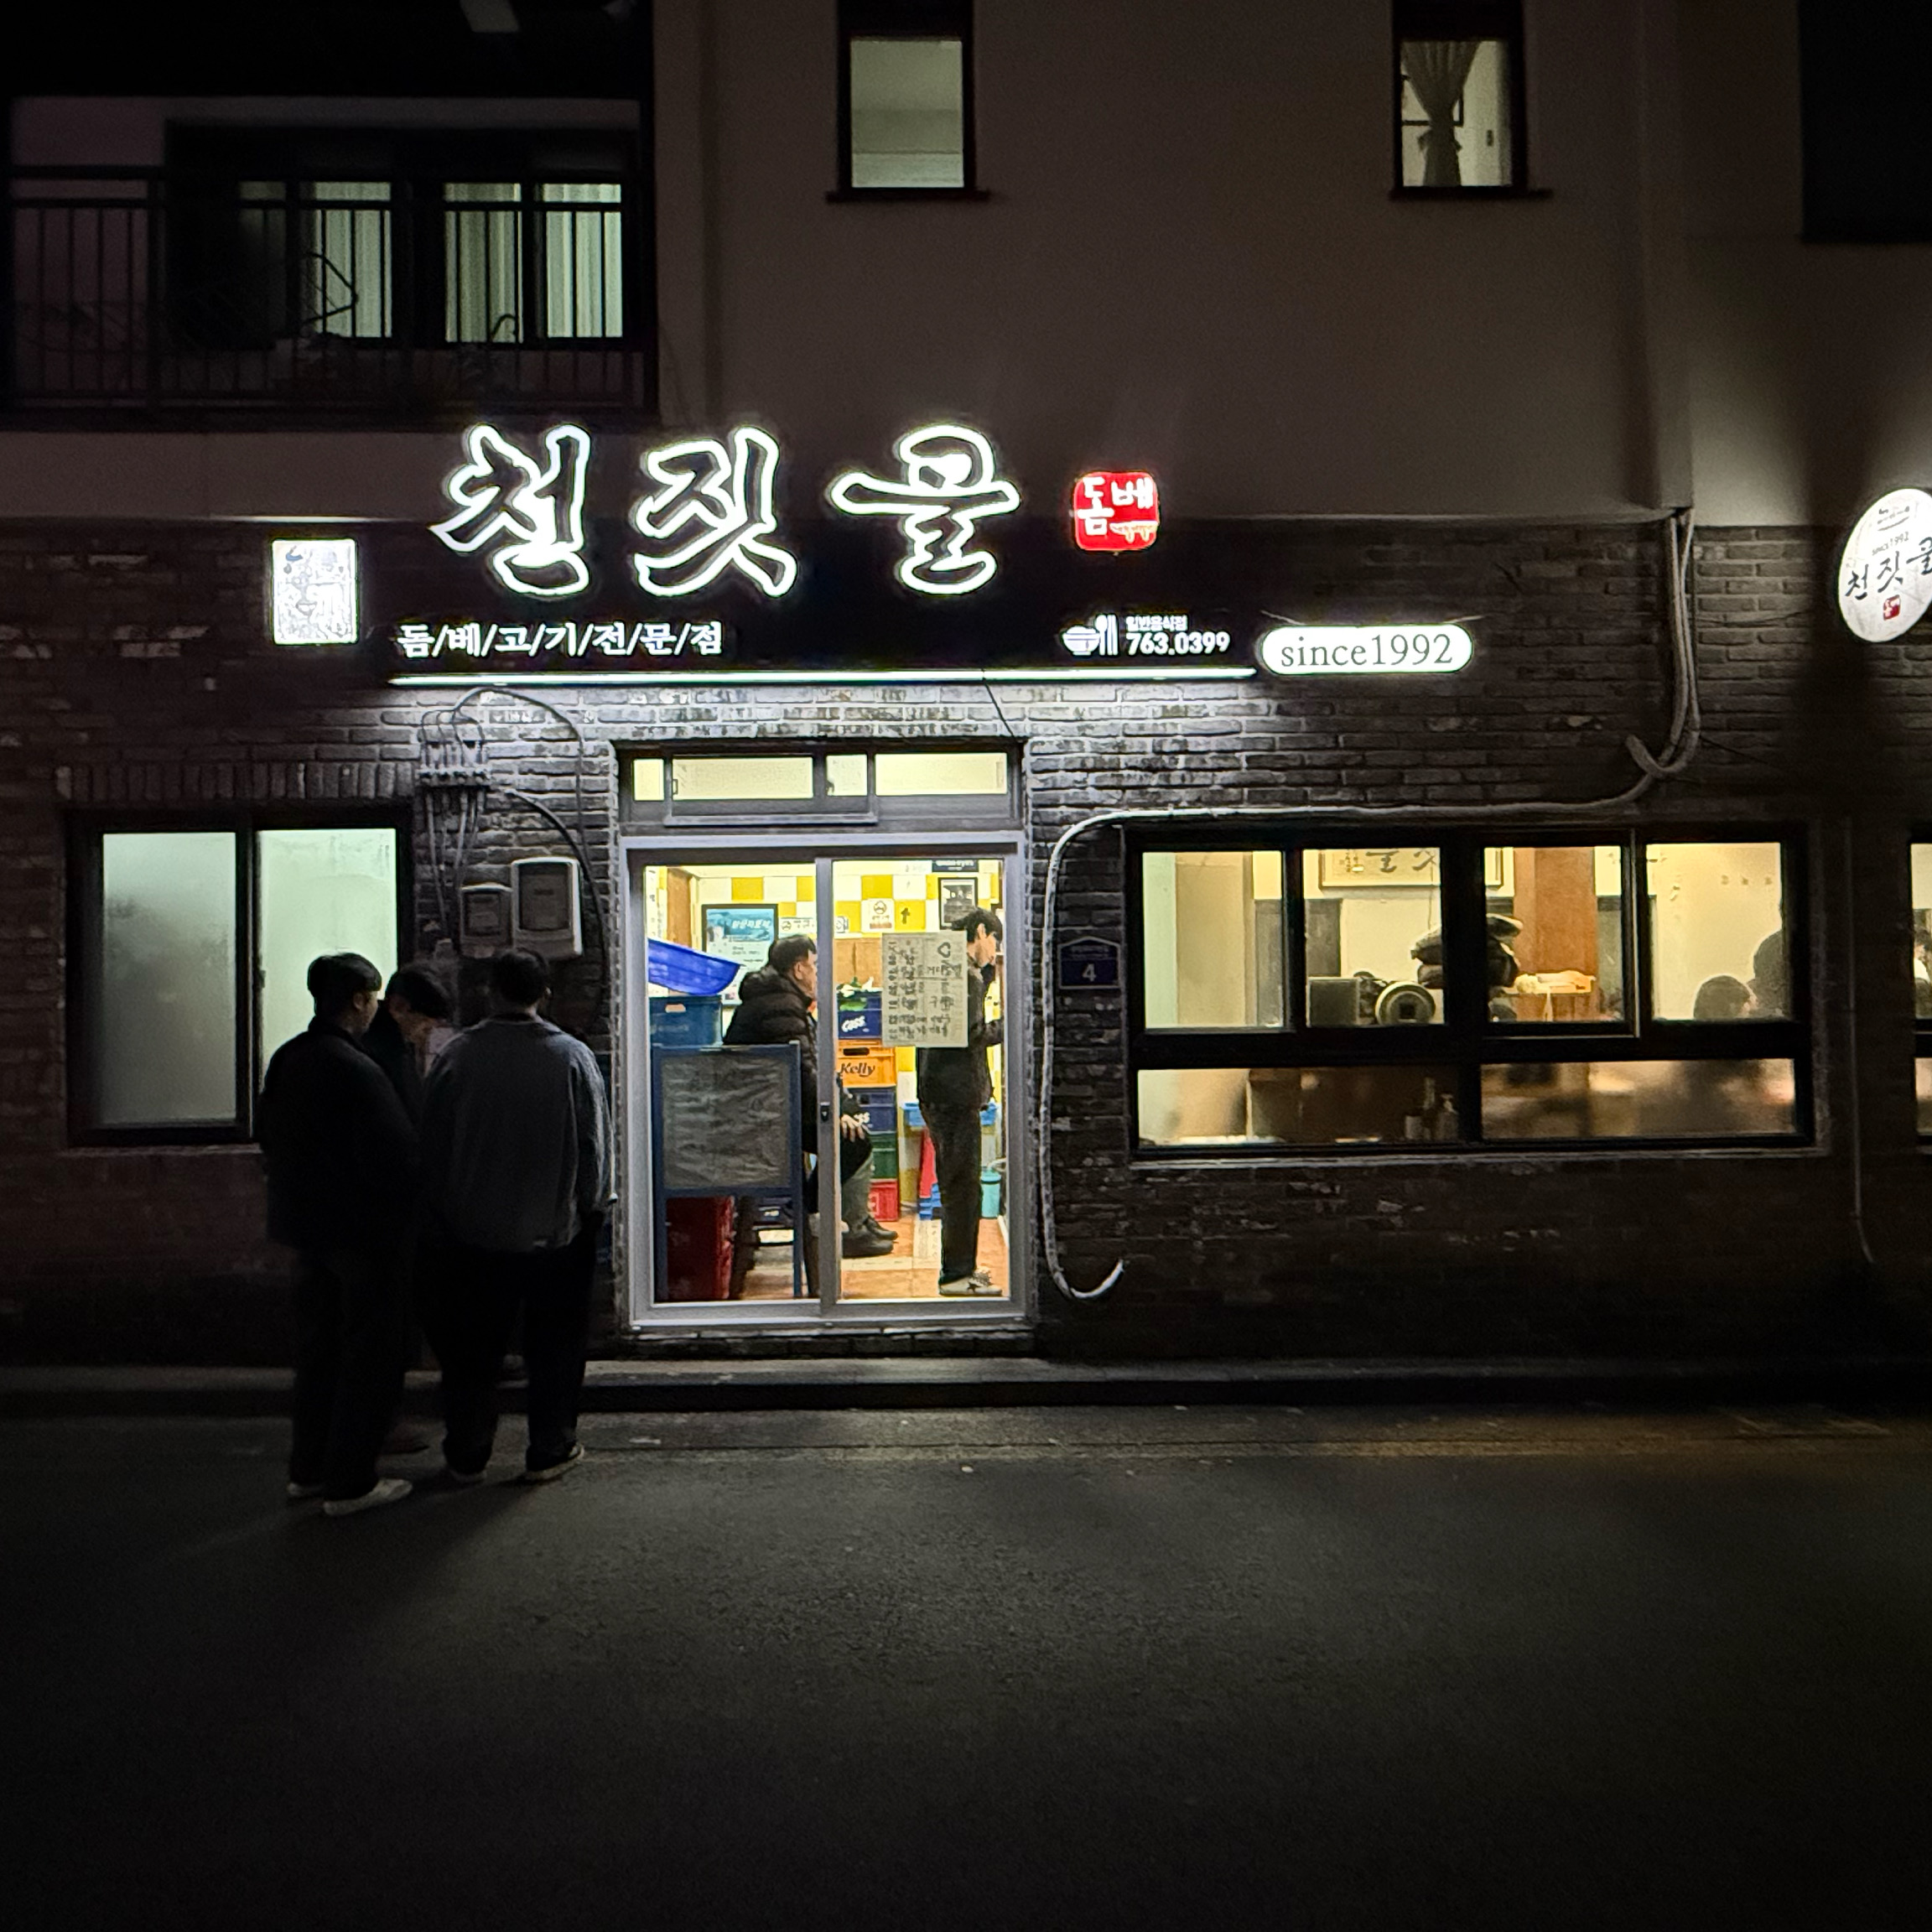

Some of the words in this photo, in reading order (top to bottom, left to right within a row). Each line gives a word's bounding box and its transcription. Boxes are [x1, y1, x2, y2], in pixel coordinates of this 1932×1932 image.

[1125, 631, 1231, 656] 763.0399
[1082, 963, 1097, 982] 4
[840, 1062, 875, 1078] Kelly
